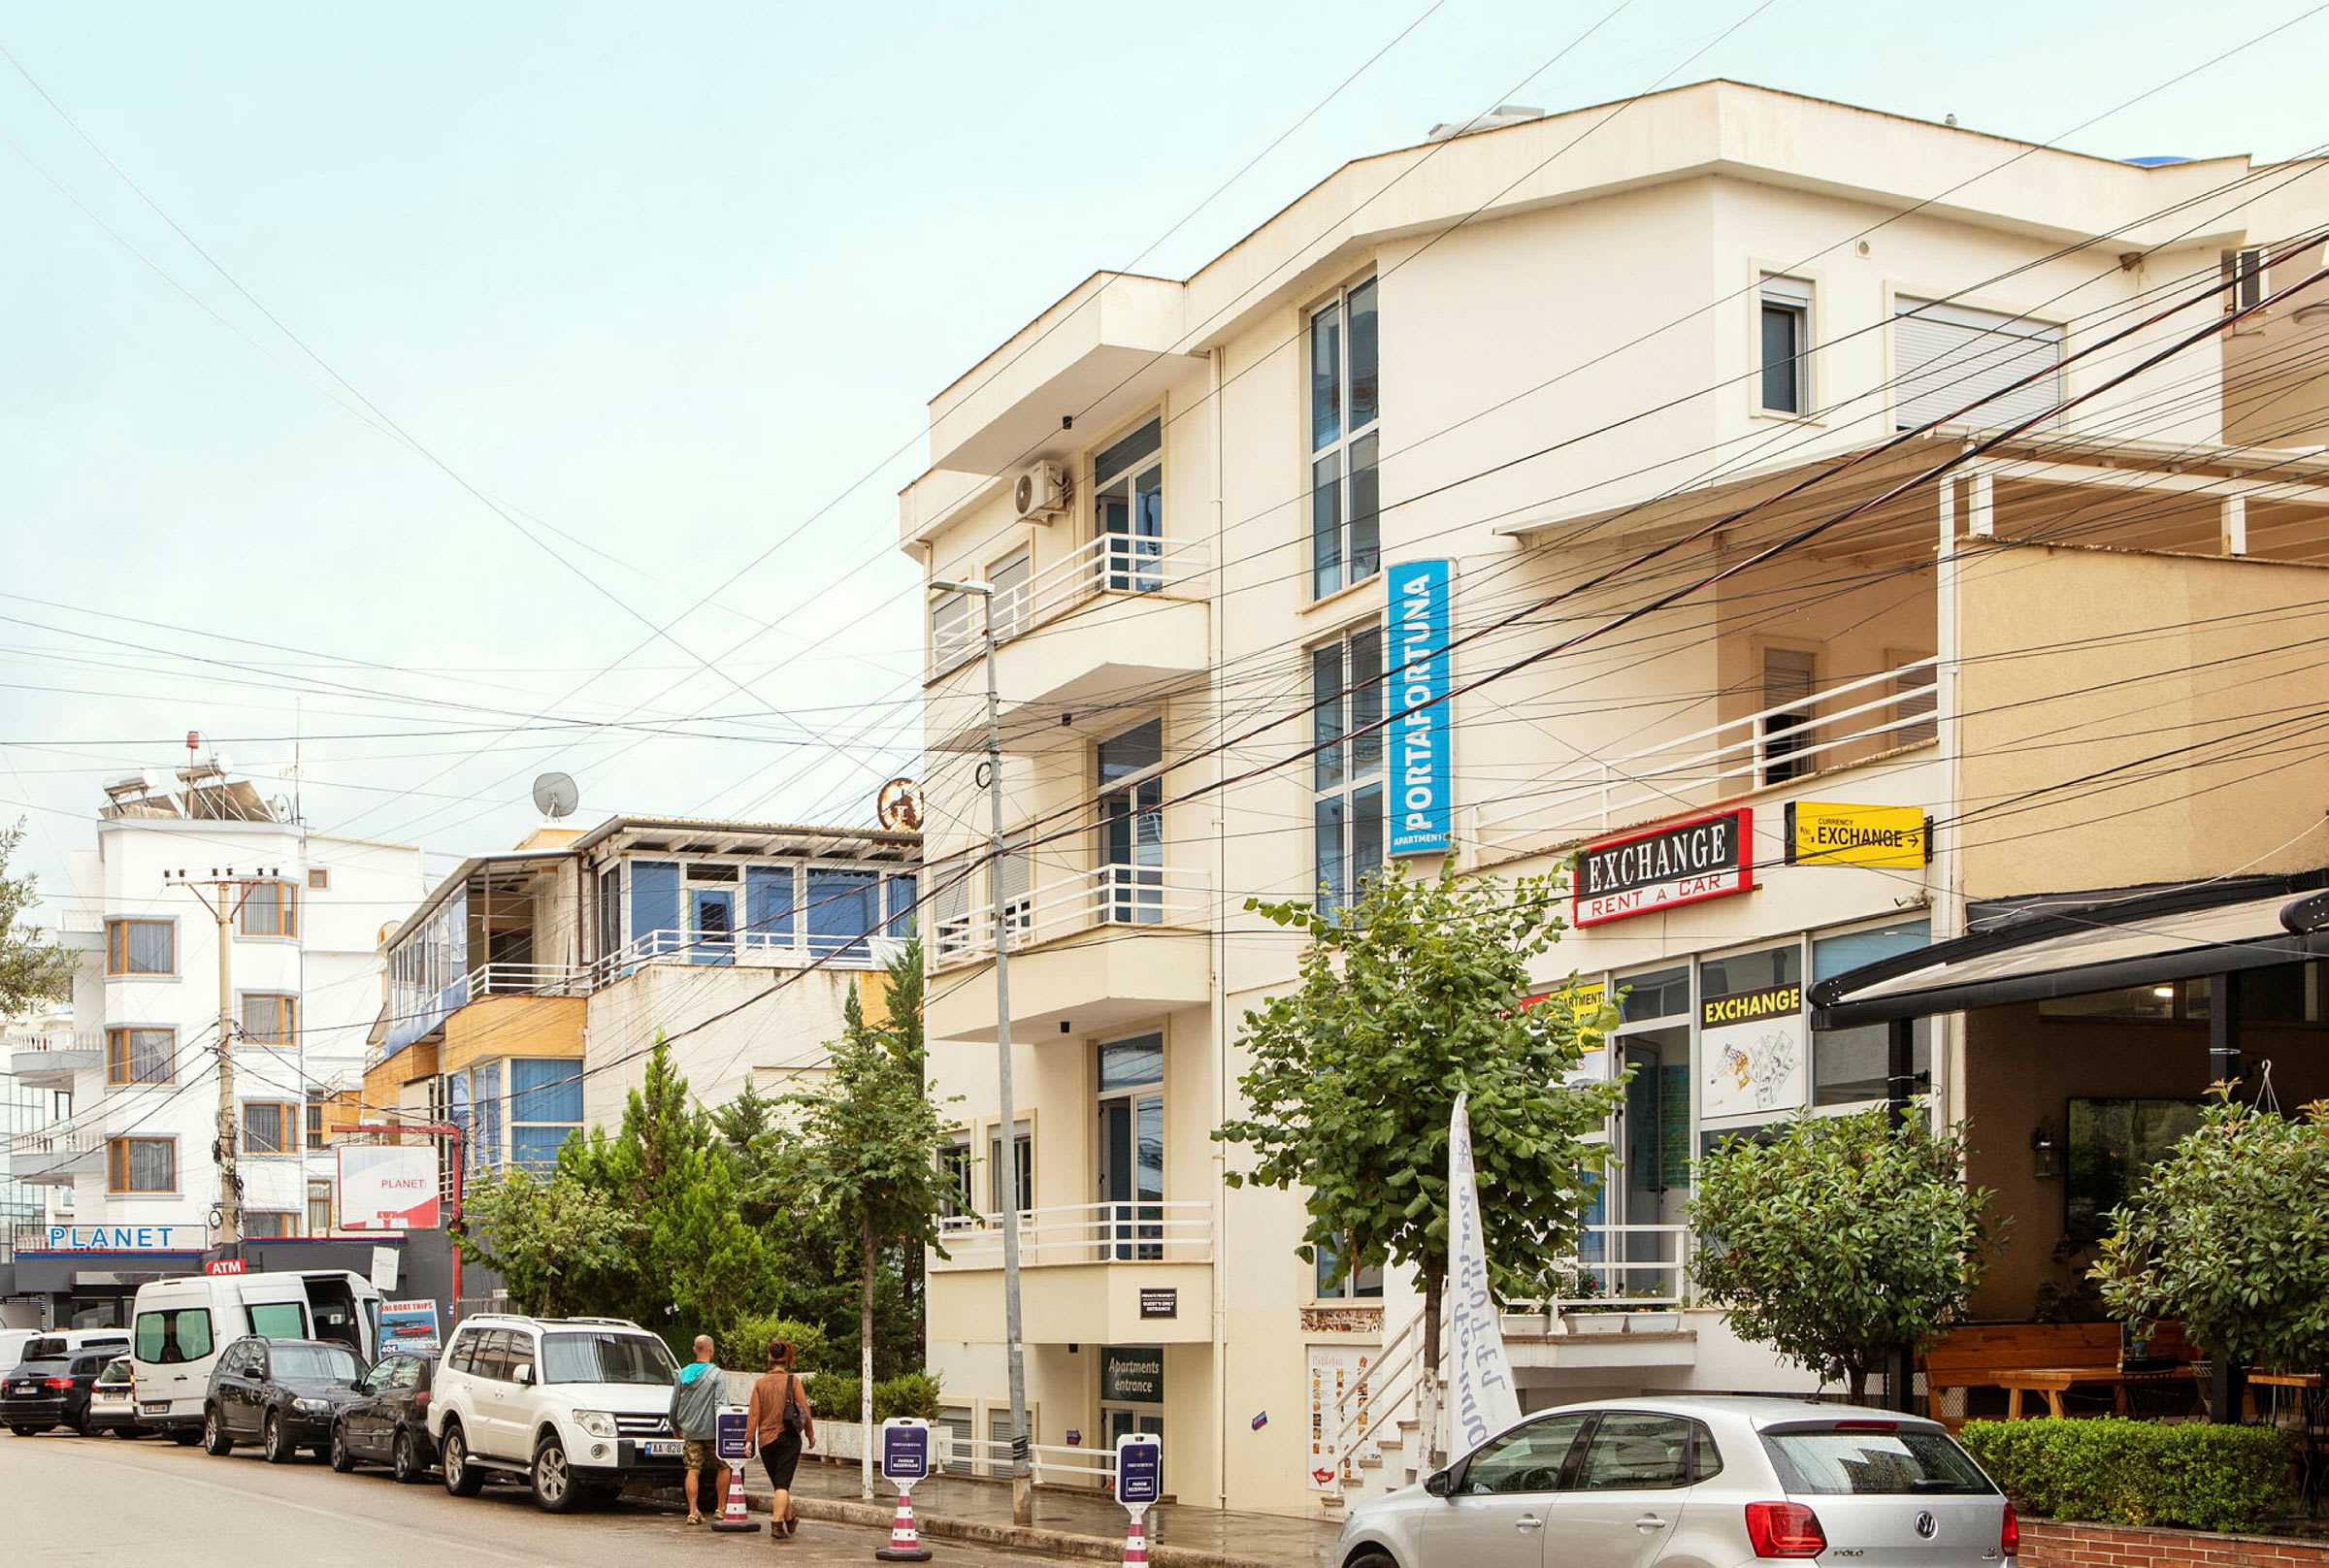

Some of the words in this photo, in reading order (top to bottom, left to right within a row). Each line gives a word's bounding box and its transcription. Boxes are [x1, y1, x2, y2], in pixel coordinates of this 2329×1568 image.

[1403, 573, 1432, 831] PORTAFORTUNA
[1818, 827, 1903, 847] EXCHANGE
[1589, 824, 1726, 894] EXCHANGE
[1591, 892, 1640, 916] RENT
[1656, 887, 1666, 901] A
[1679, 875, 1721, 897] CAR
[1705, 988, 1799, 1023] EXCHANGE
[381, 1179, 424, 1189] PLANET
[49, 1227, 173, 1247] PLANET
[213, 1260, 241, 1274] ATM
[1108, 1356, 1160, 1377] Apartments
[1115, 1378, 1153, 1392] entrance
